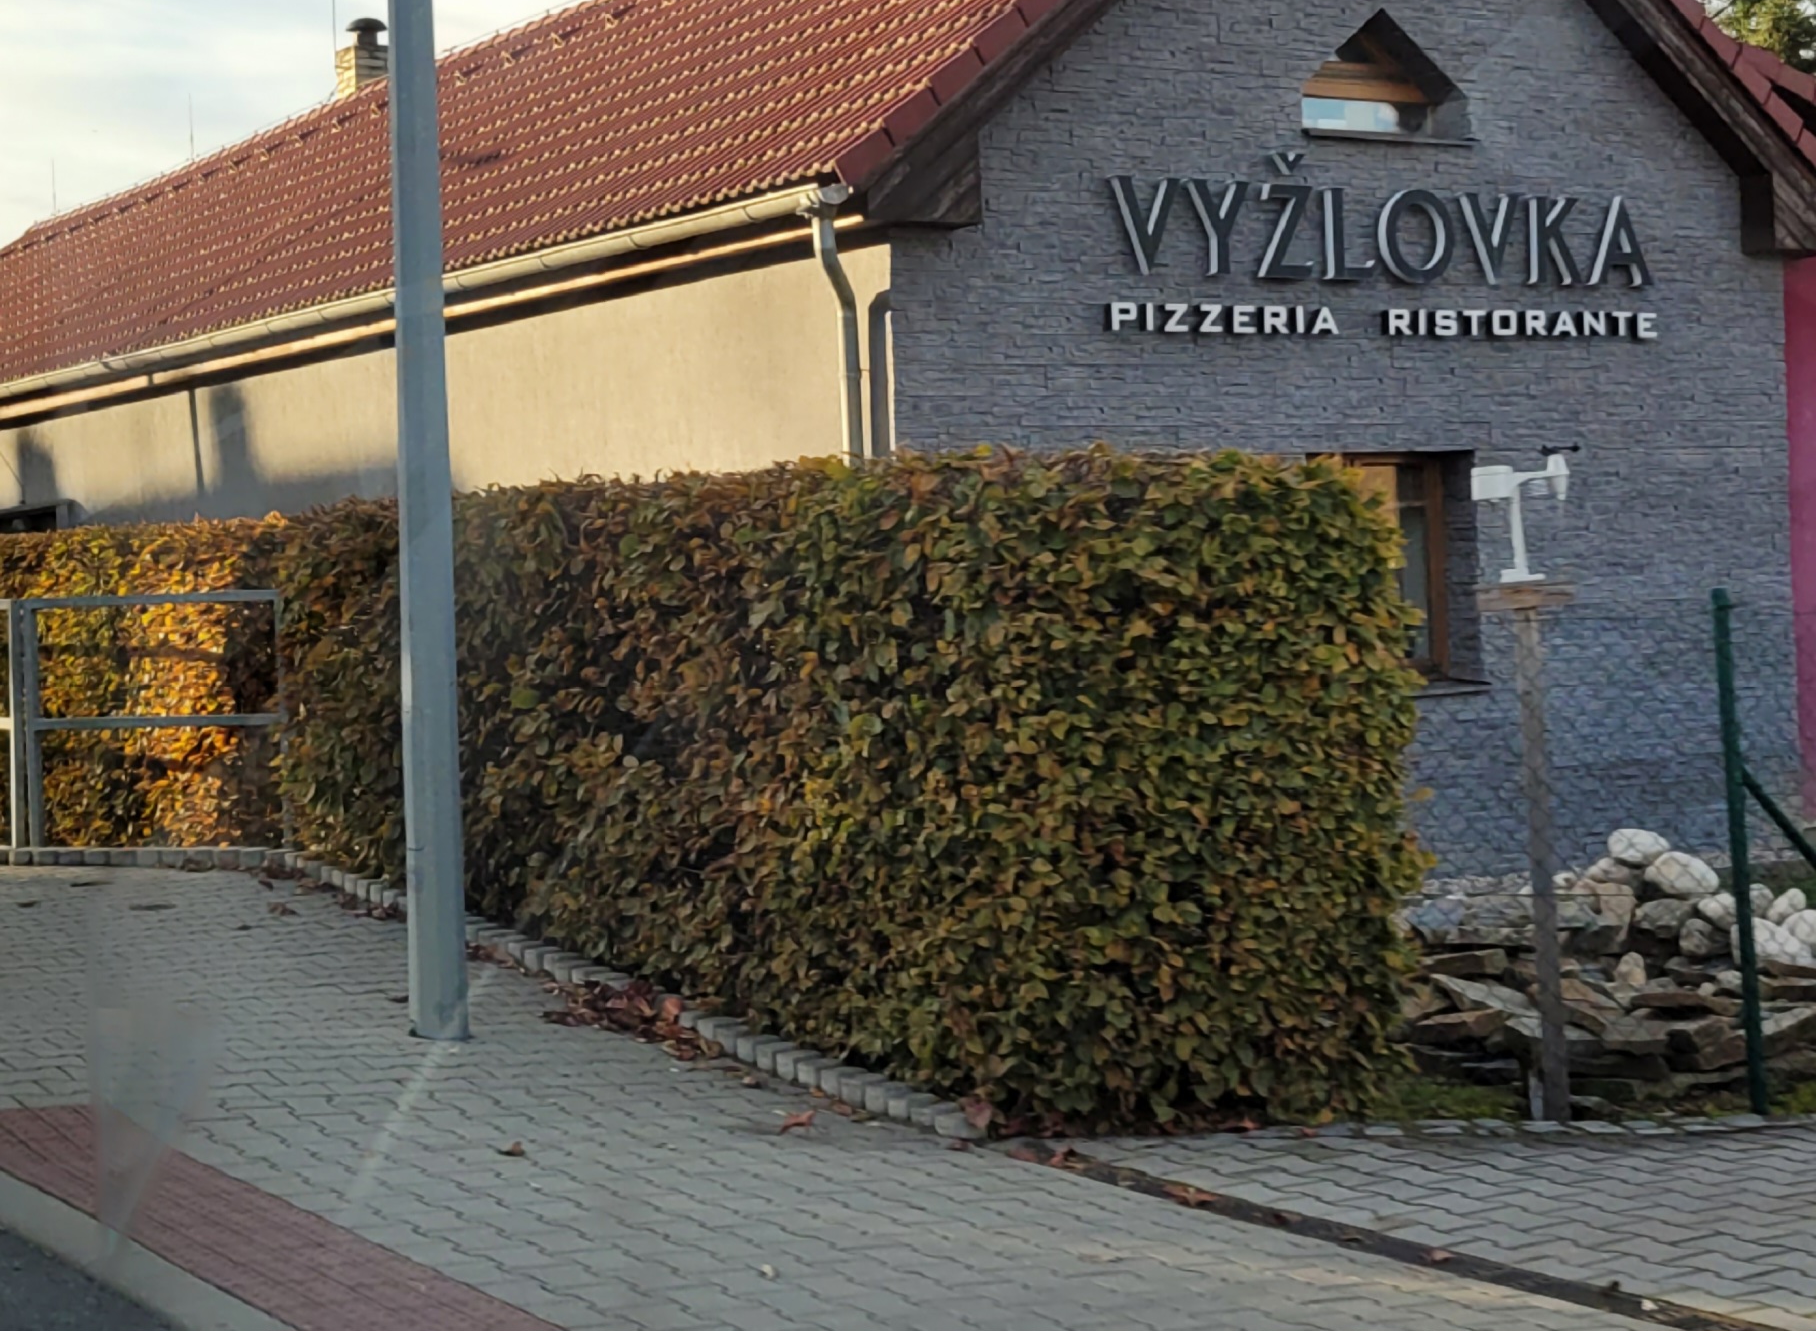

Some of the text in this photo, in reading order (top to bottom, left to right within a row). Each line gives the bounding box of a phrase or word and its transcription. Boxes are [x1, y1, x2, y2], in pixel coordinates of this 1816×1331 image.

[1107, 152, 1654, 287] VYŽLOVKA
[1108, 301, 1659, 339] PIZZERIA RISTORANTE
